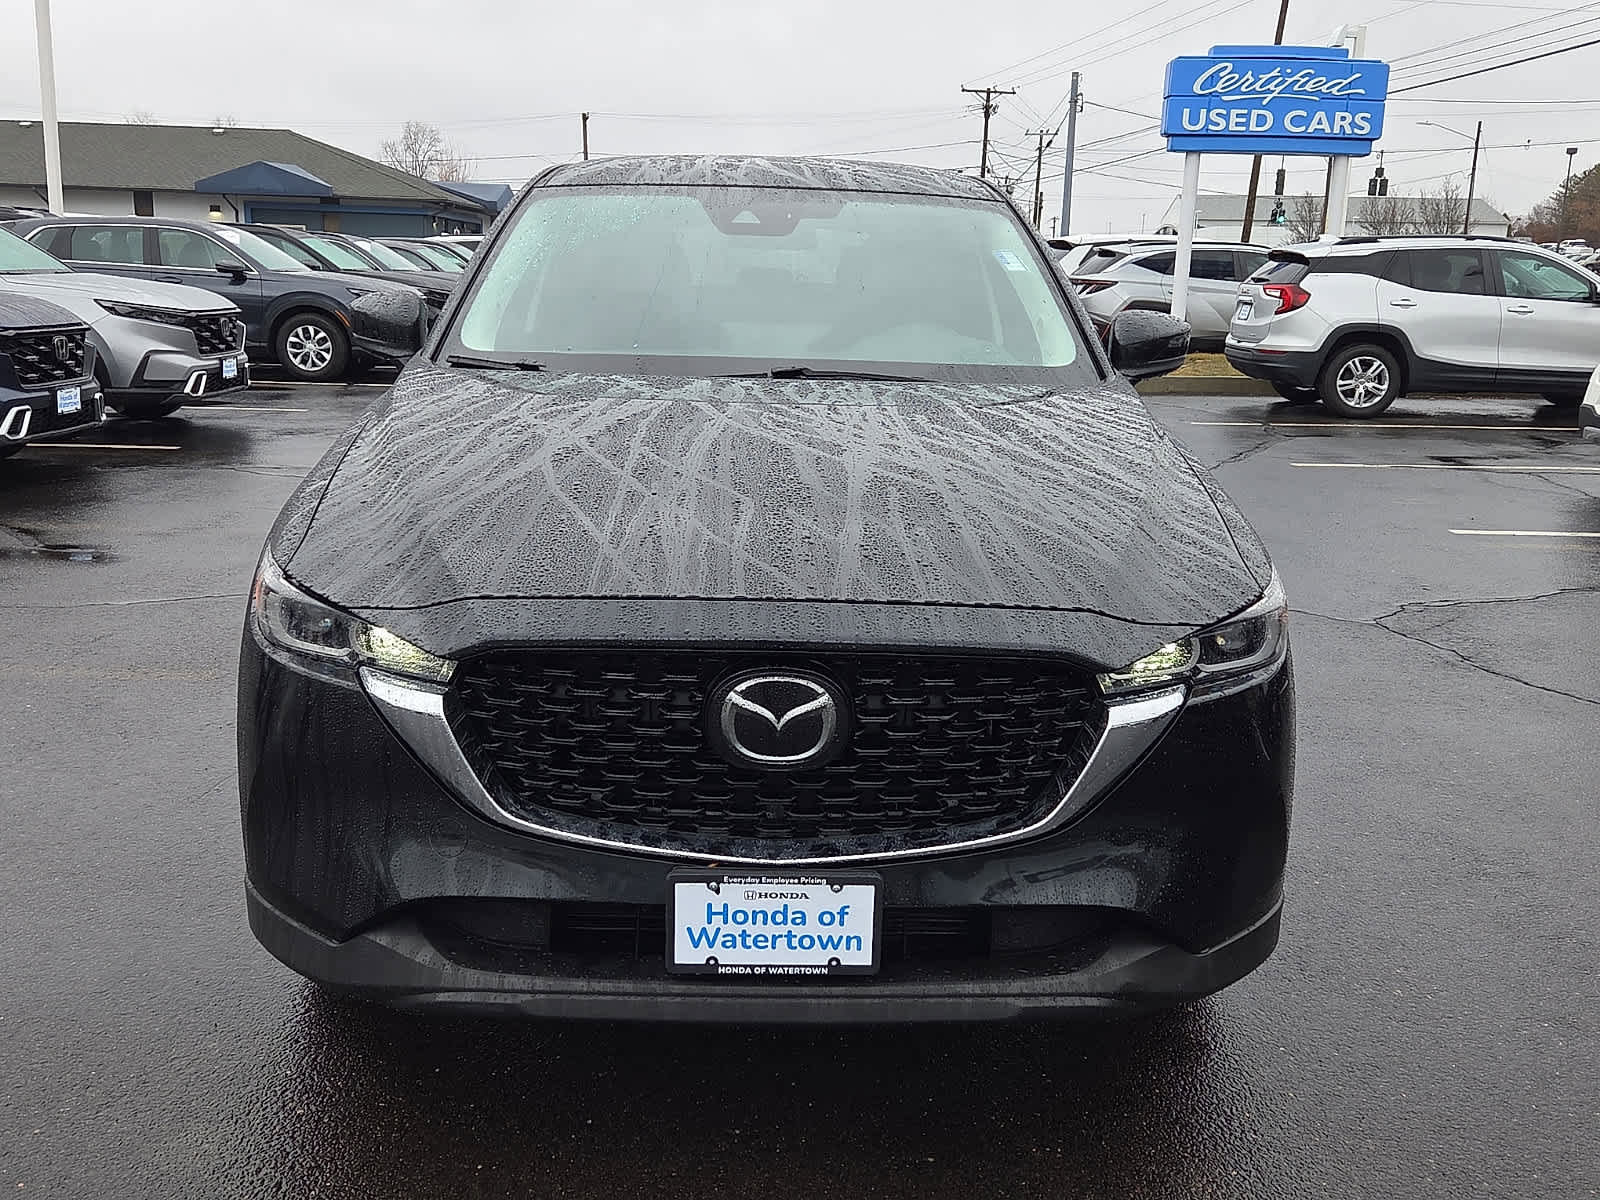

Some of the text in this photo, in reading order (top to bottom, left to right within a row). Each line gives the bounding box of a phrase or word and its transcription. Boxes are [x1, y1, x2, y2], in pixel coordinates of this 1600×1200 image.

[1192, 62, 1366, 106] Certified
[1181, 108, 1372, 136] USED CARS
[723, 876, 827, 886] Everyday Employee Pricing
[757, 891, 810, 900] HONDA
[705, 902, 850, 927] Honda of
[686, 926, 863, 952] Watertown
[718, 966, 829, 975] HONDA OF WATERTOWN
